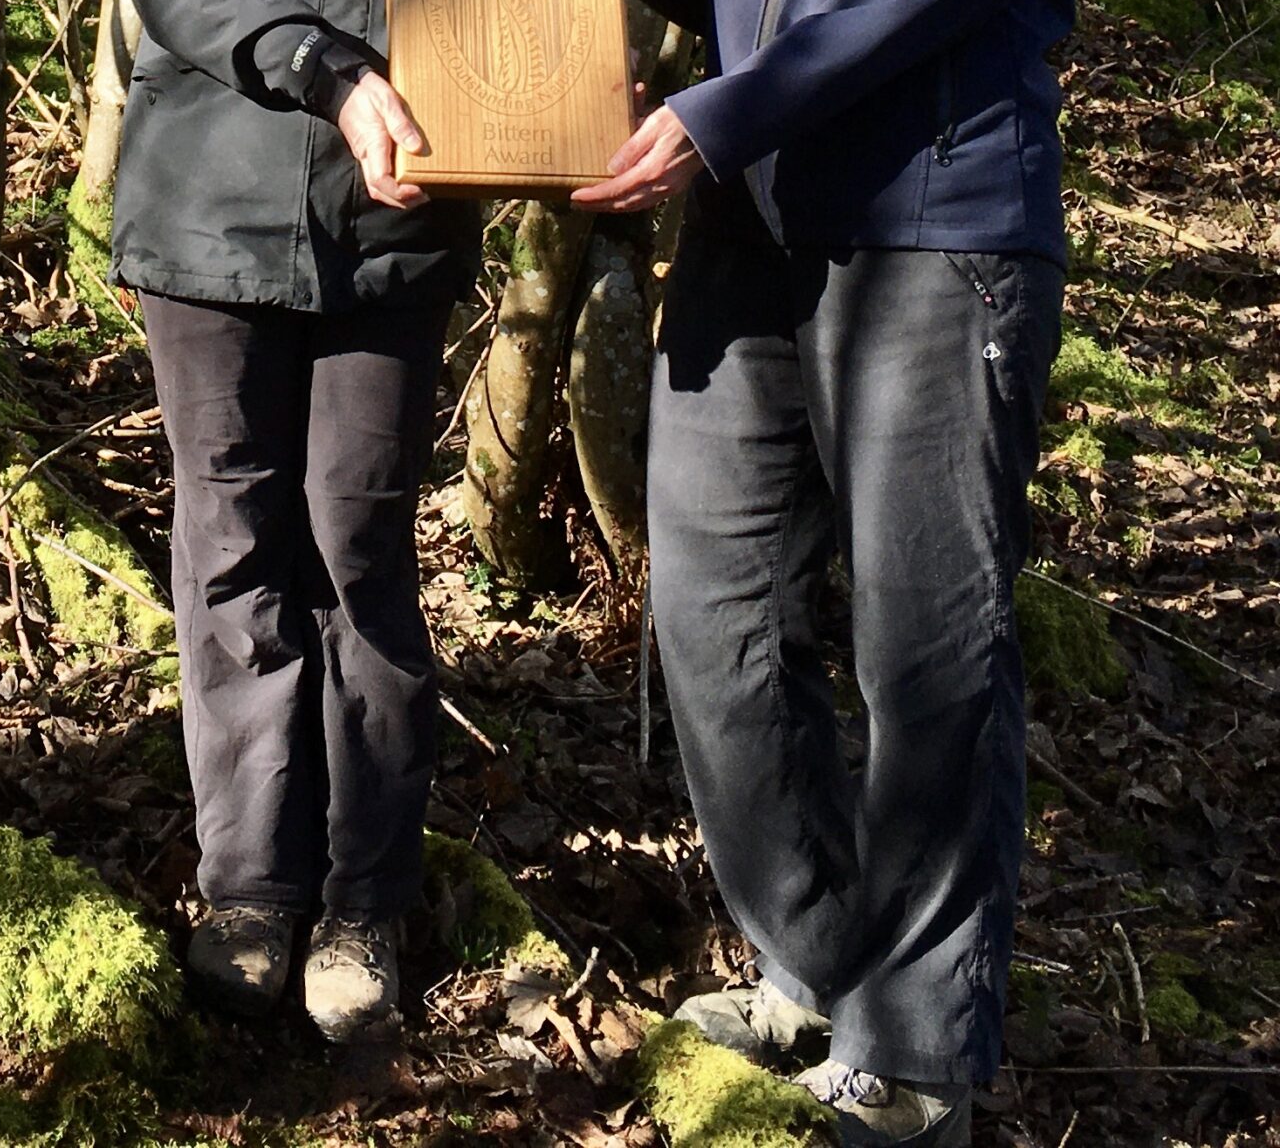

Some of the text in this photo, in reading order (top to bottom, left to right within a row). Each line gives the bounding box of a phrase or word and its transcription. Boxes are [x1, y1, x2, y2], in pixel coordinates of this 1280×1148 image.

[429, 2, 593, 112] Area of Outstanding Natural Beauty
[483, 122, 553, 143] Bittern
[483, 145, 554, 165] Award
